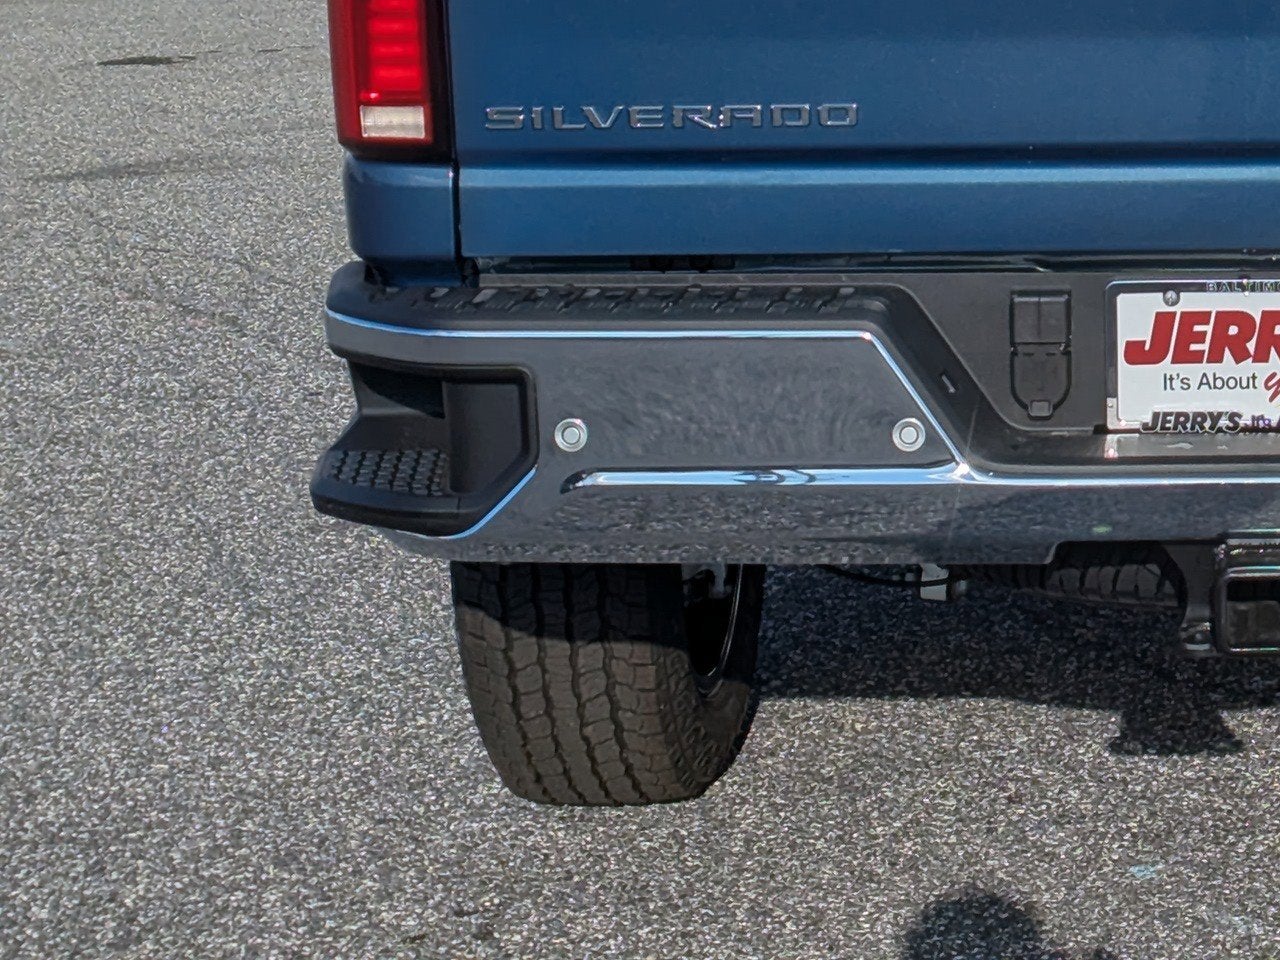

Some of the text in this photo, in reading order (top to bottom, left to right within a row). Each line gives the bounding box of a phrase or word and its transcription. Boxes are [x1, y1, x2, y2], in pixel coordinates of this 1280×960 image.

[485, 103, 859, 130] SILVERADO
[1163, 372, 1191, 391] It's
[1197, 372, 1258, 391] About
[1140, 410, 1245, 434] JERRY'S
[1250, 413, 1272, 429] It's
